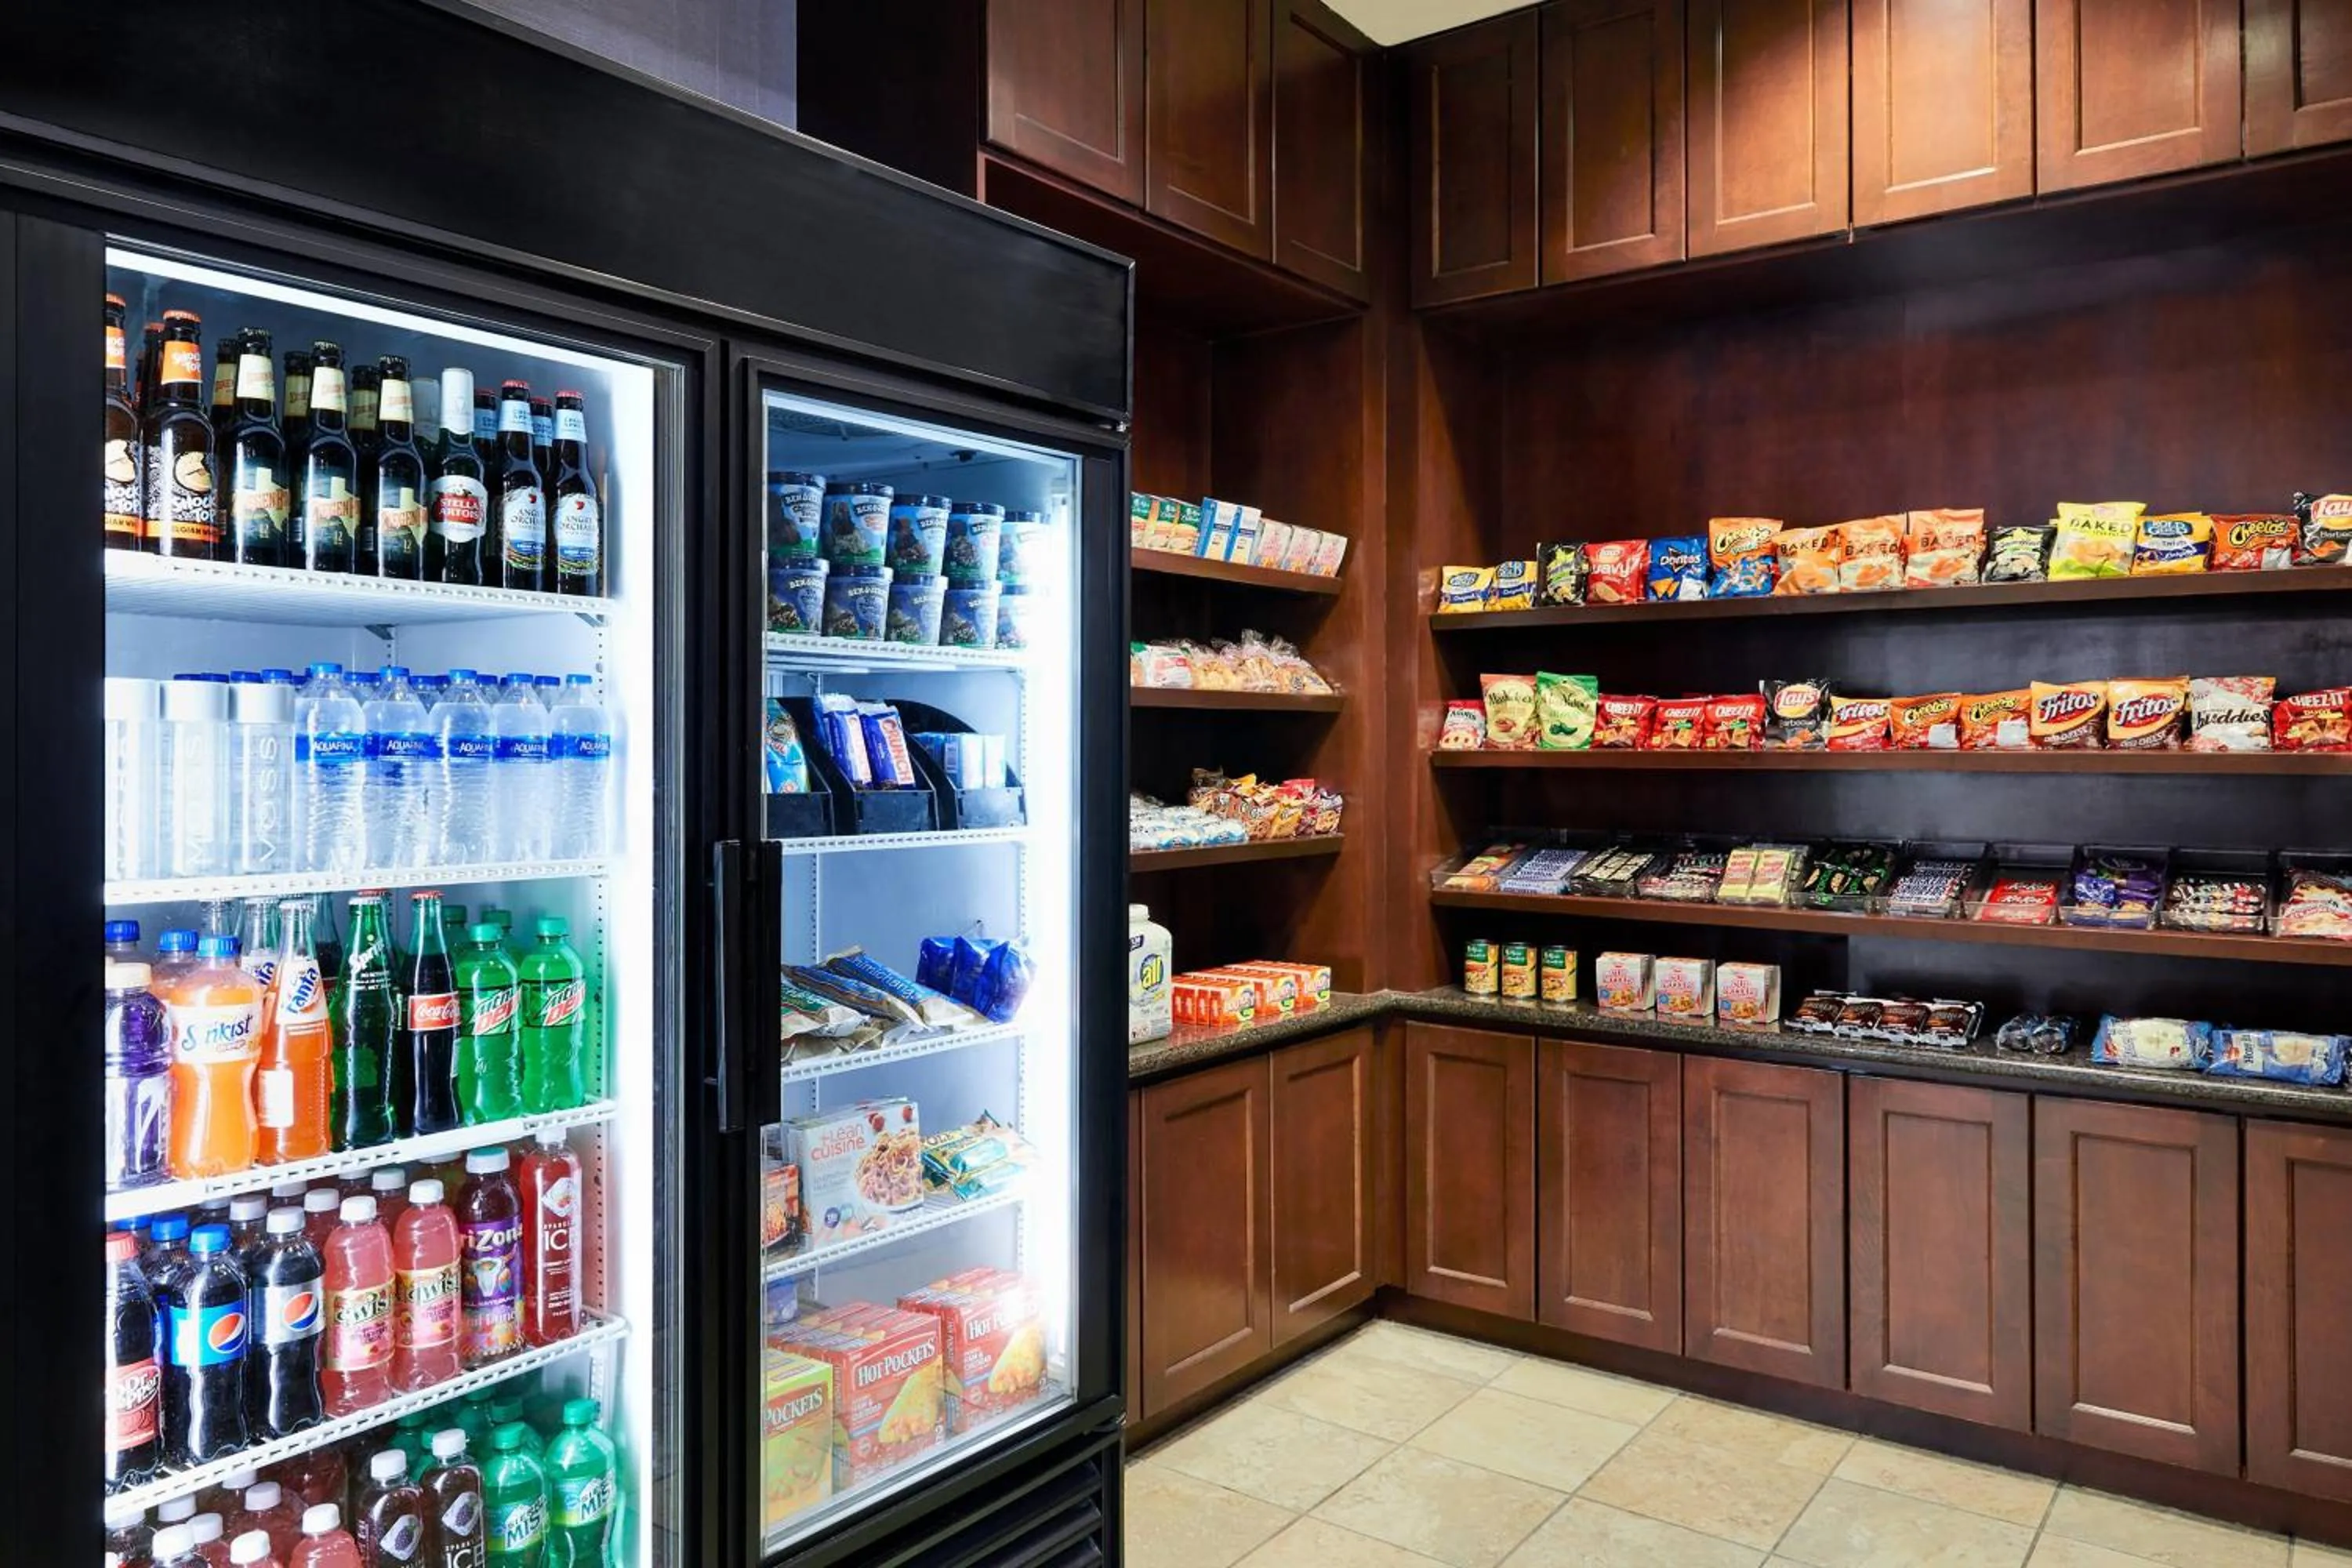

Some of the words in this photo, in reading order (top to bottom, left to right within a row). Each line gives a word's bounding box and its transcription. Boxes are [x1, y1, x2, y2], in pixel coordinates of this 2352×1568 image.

[440, 498, 479, 510] STELLA
[2069, 518, 2134, 534] BAKED
[2230, 520, 2288, 549] Cheetos
[1660, 554, 1701, 565] Doritos
[1780, 537, 1829, 554] BAKED
[1780, 691, 1817, 707] Lay's
[2037, 691, 2099, 723] Fritos
[2116, 696, 2180, 726] Fritos
[314, 740, 361, 753] AQUAFINA
[881, 717, 913, 782] CRUNCH
[1142, 959, 1162, 990] all
[287, 967, 319, 1014] Fanta
[181, 1013, 254, 1051] Snkist
[968, 1317, 992, 1340] HOT
[858, 1363, 884, 1387] HOT
[884, 1338, 936, 1376] POCKETS
[507, 1515, 541, 1548] MIS
